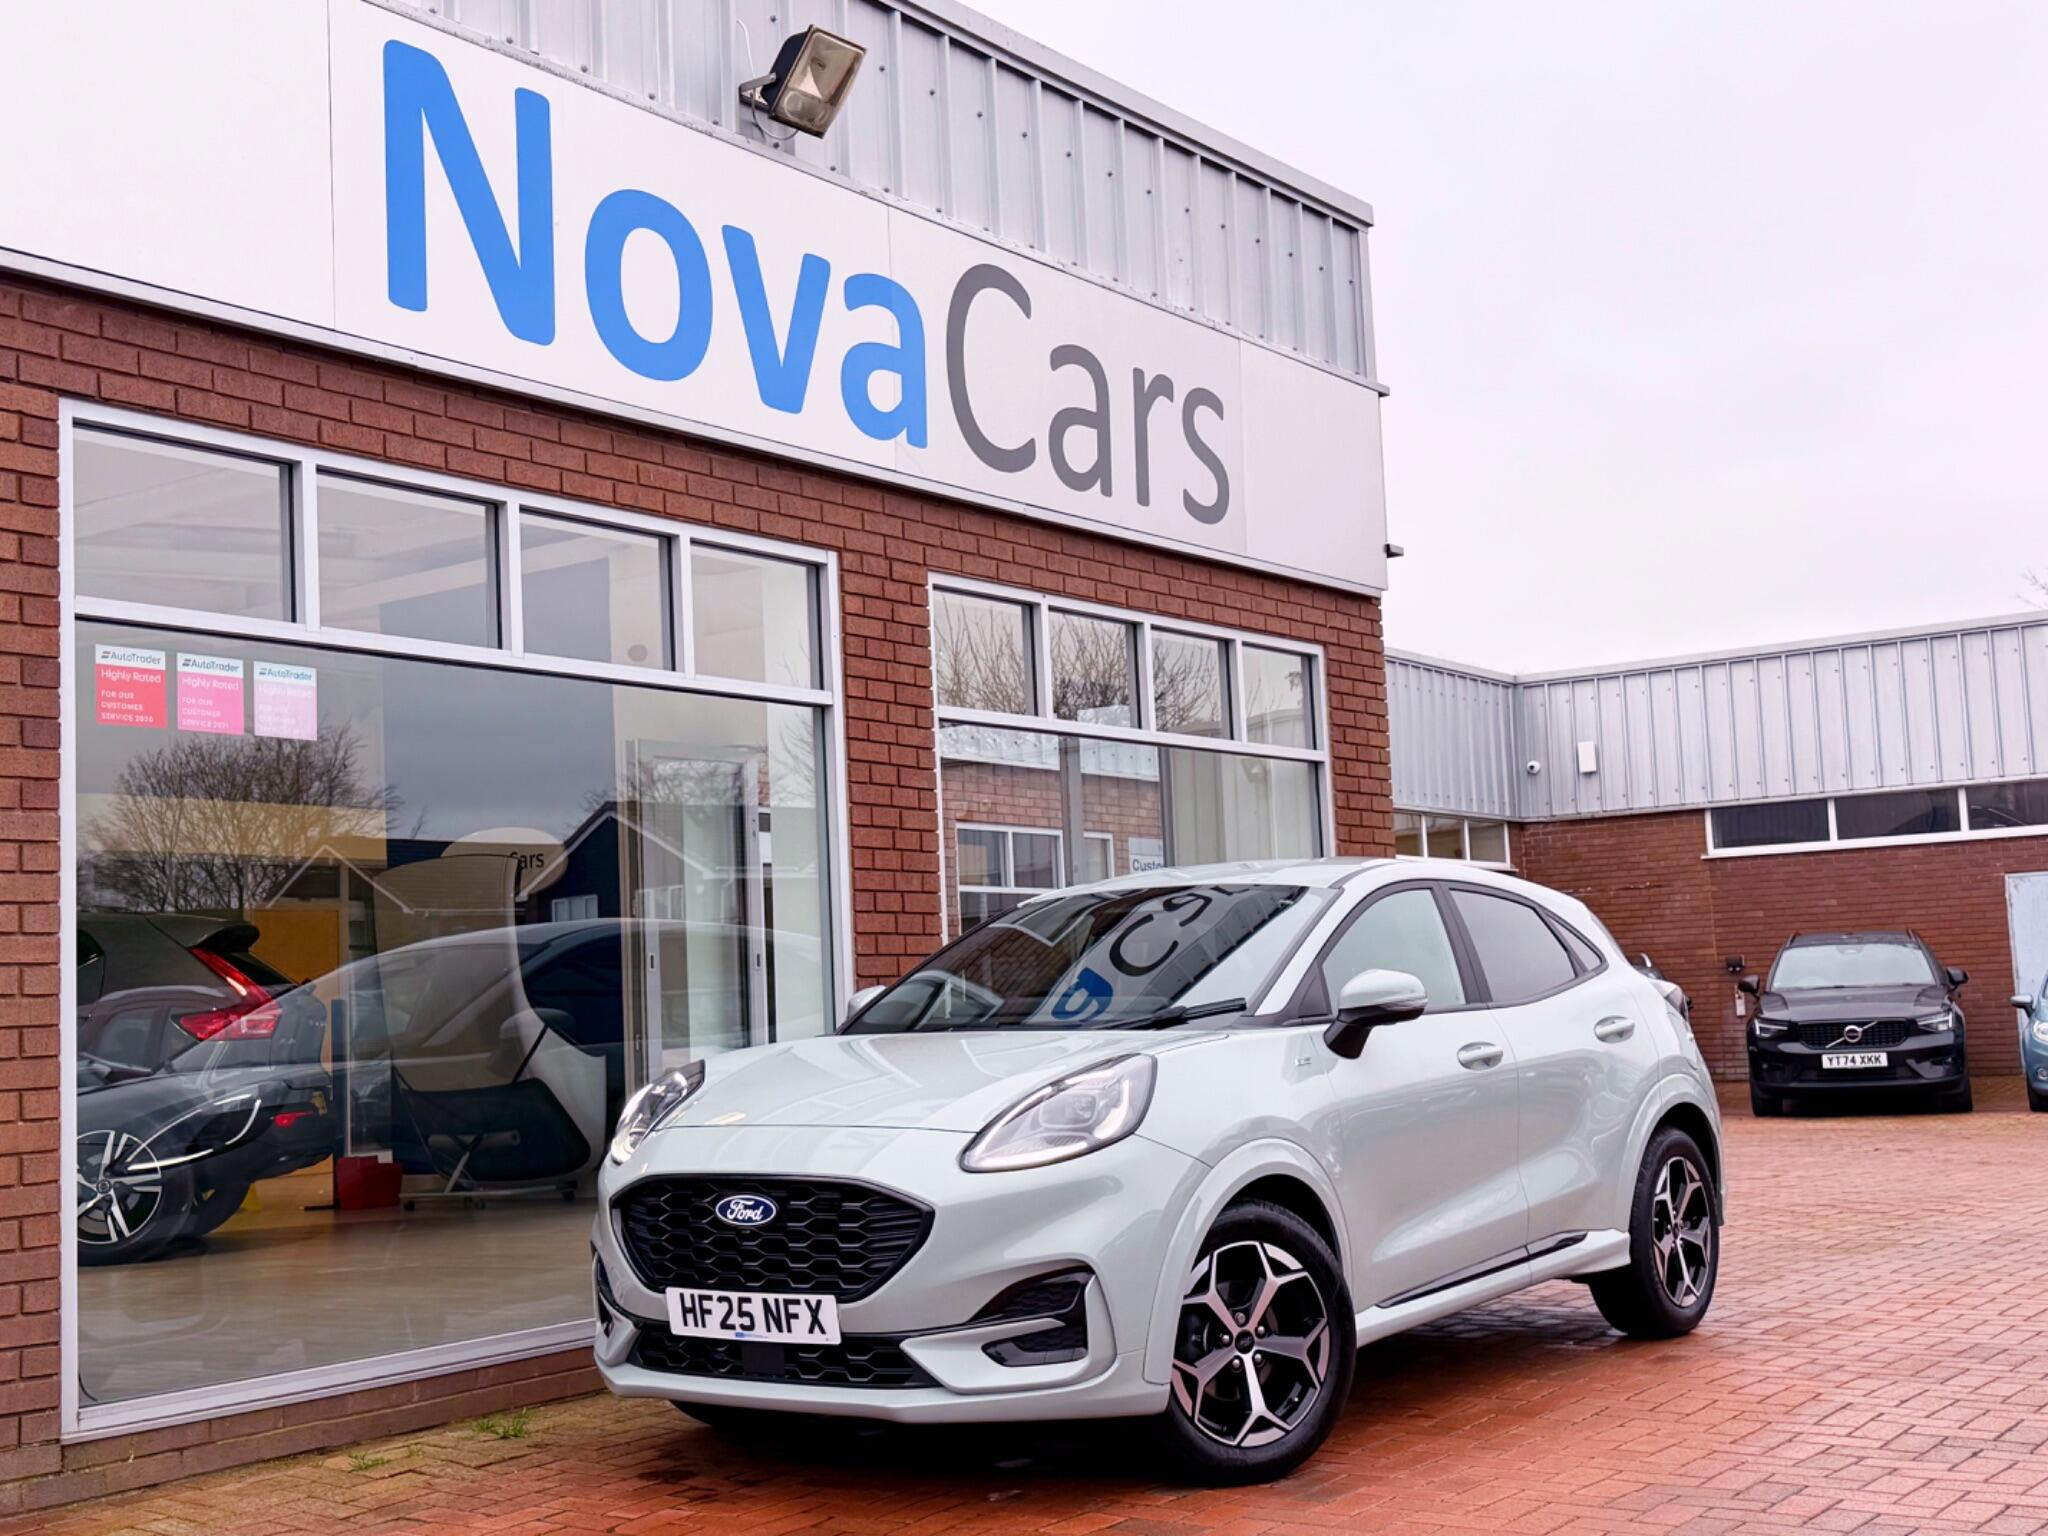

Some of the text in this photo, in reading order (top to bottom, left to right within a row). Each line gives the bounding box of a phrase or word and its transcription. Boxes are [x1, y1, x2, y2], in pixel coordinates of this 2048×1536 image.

[382, 39, 1230, 526] NovaCars
[111, 651, 161, 665] AutoTrader
[191, 659, 240, 673] AutoTrader
[101, 668, 161, 684] Highly Rated
[1827, 1054, 1882, 1066] YT74 XKK
[726, 1199, 764, 1221] Ford
[679, 1292, 827, 1335] HF25 NFX
